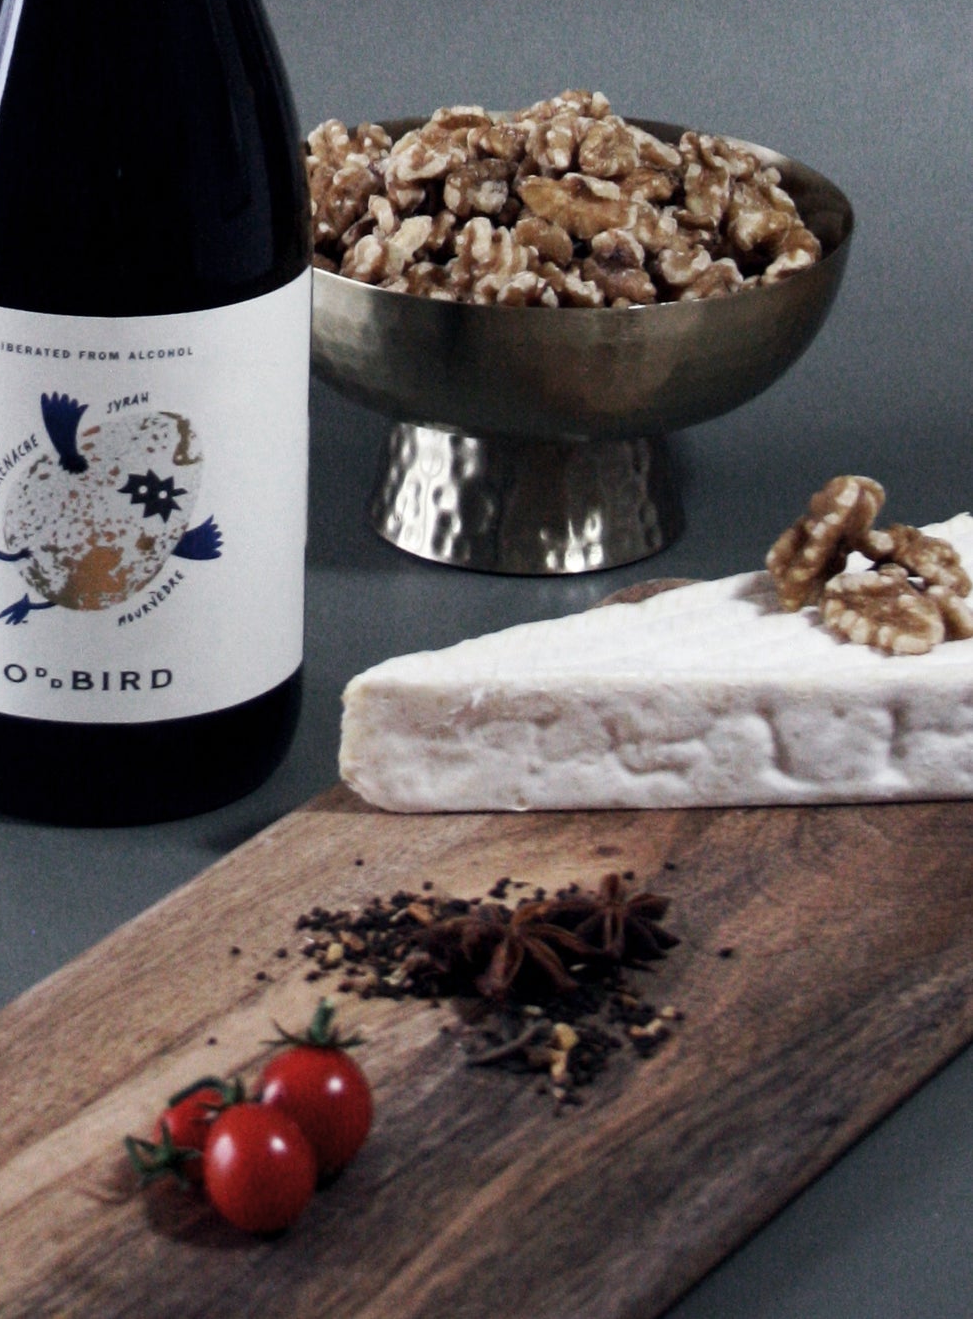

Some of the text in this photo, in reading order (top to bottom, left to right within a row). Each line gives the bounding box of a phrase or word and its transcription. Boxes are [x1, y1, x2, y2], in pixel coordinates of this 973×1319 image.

[78, 350, 120, 361] FROM
[127, 346, 194, 360] ALCOHOL
[106, 391, 149, 414] SYRAH
